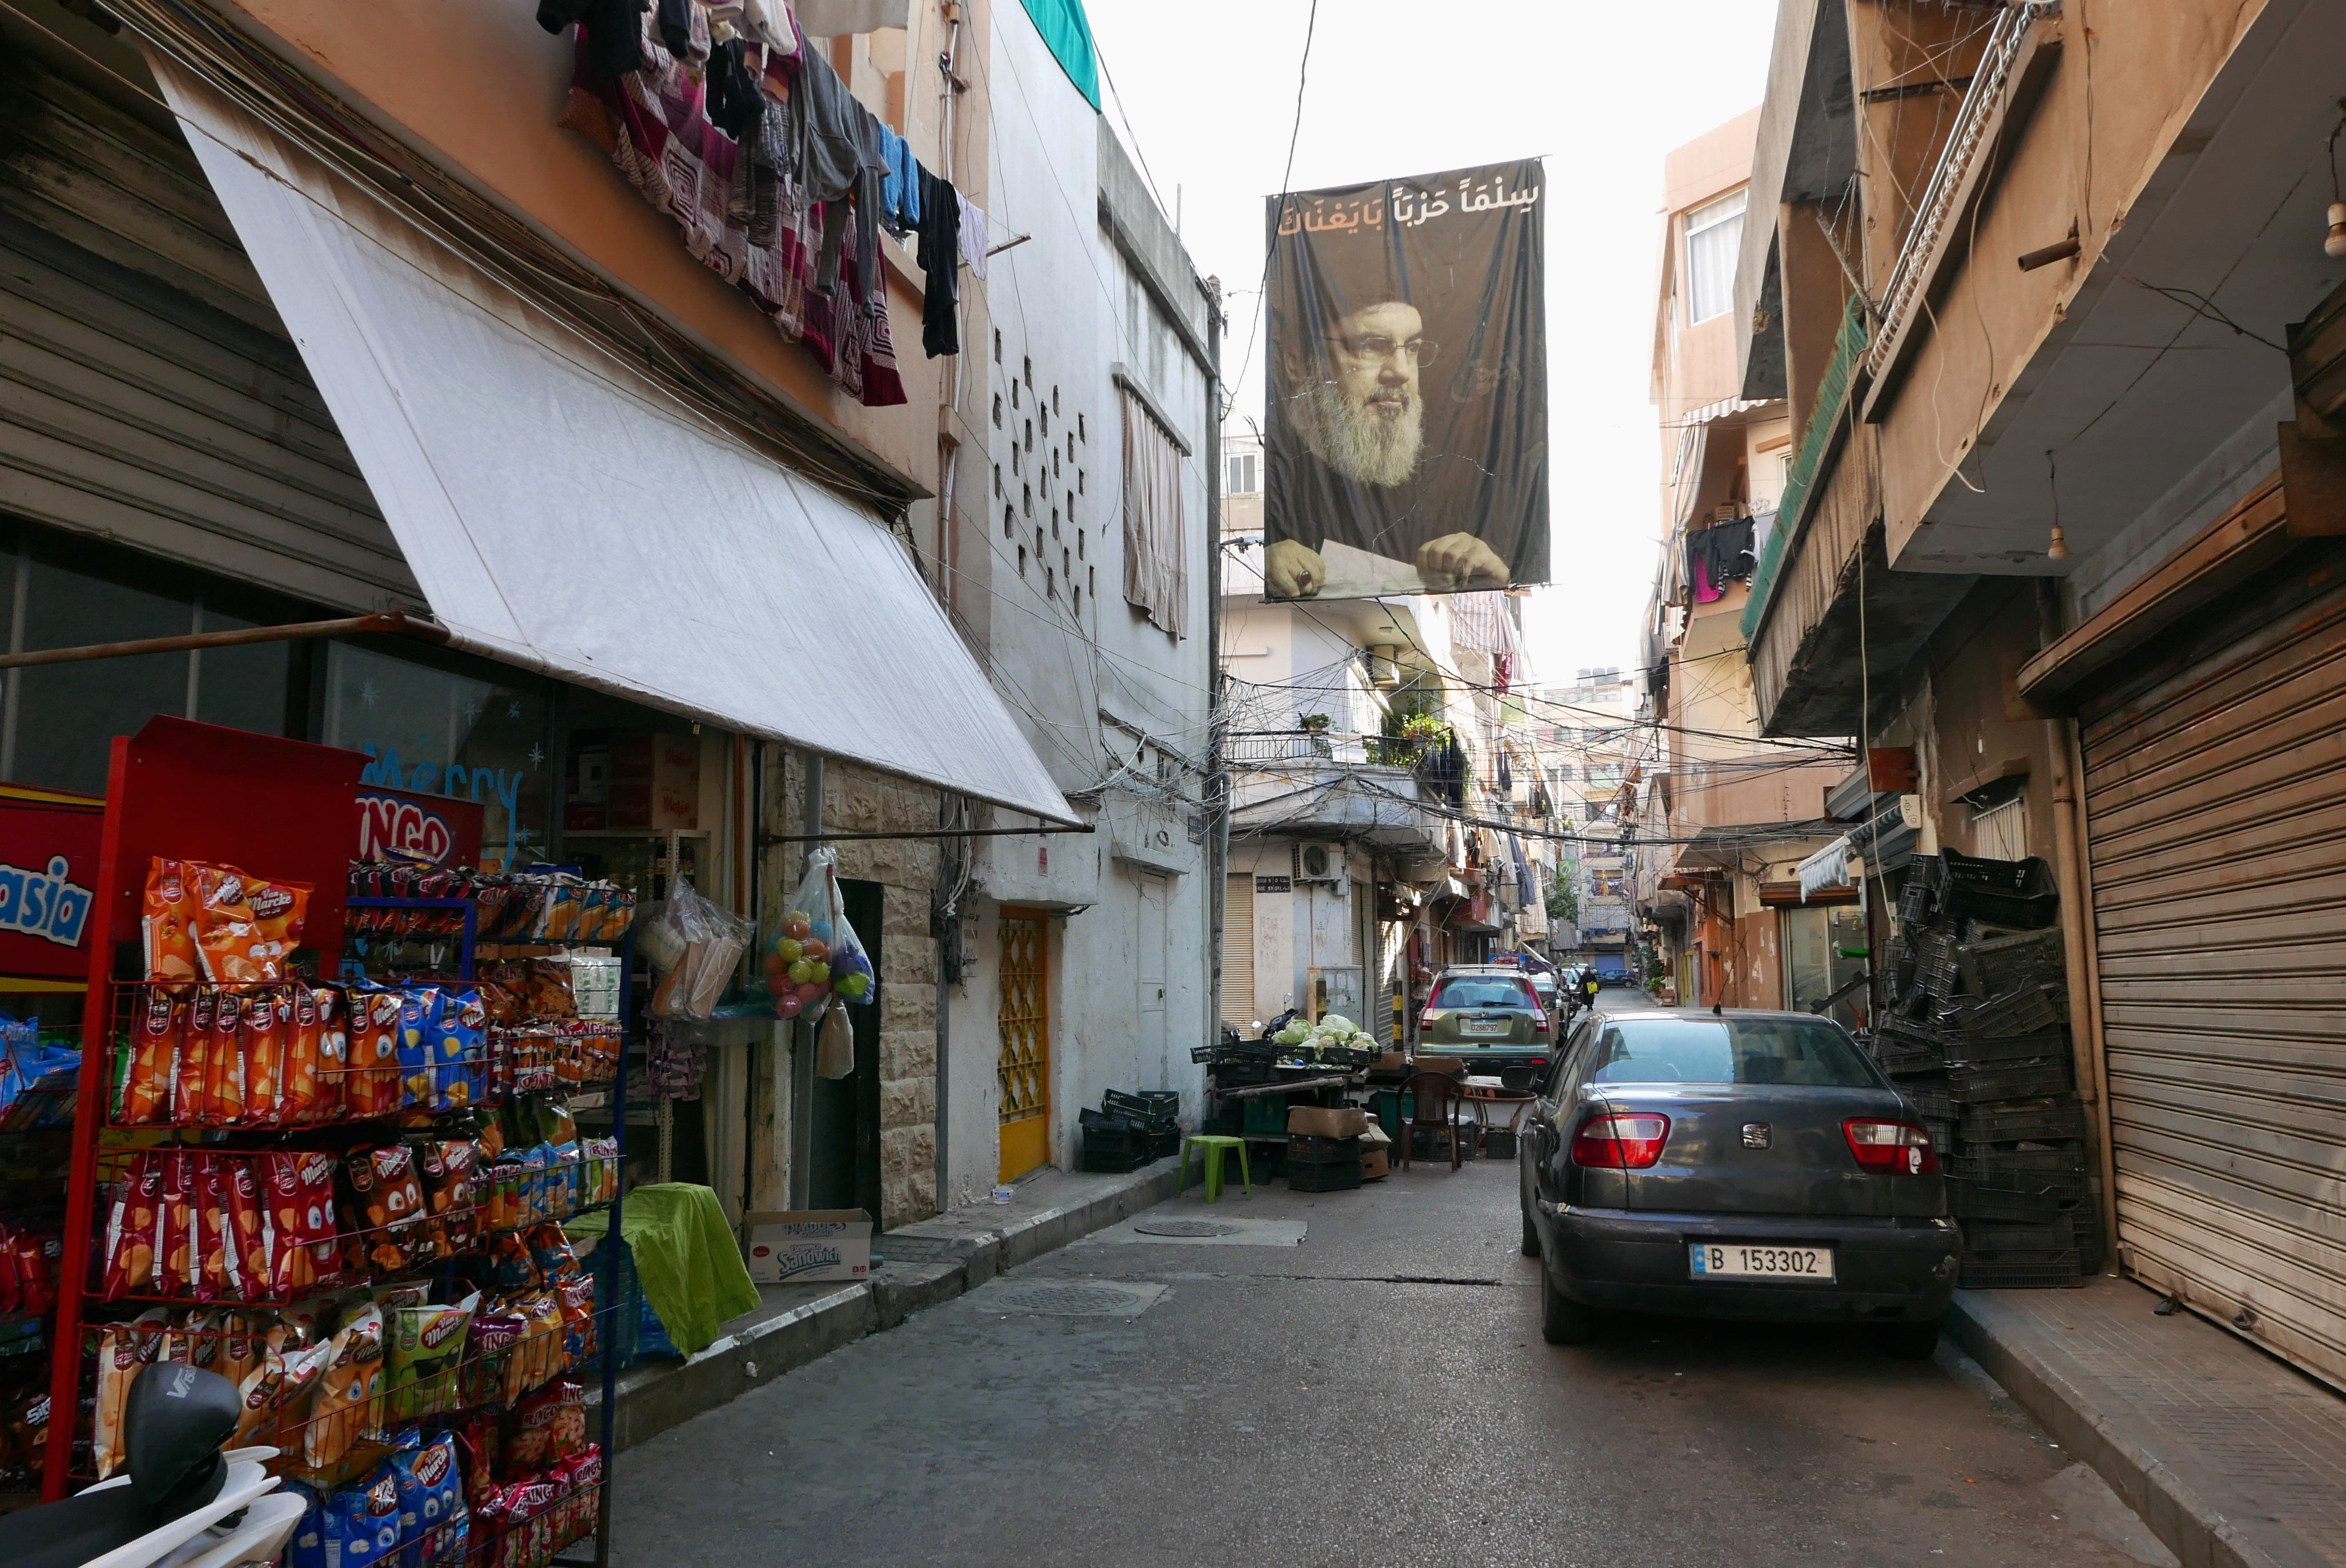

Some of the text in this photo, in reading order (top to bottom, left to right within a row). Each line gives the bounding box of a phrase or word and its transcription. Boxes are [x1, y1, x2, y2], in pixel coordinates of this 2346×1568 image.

[355, 797, 450, 863] INGO
[361, 741, 524, 874] Merry
[777, 1247, 841, 1273] Sandwich
[1711, 1248, 1818, 1273] B 153302
